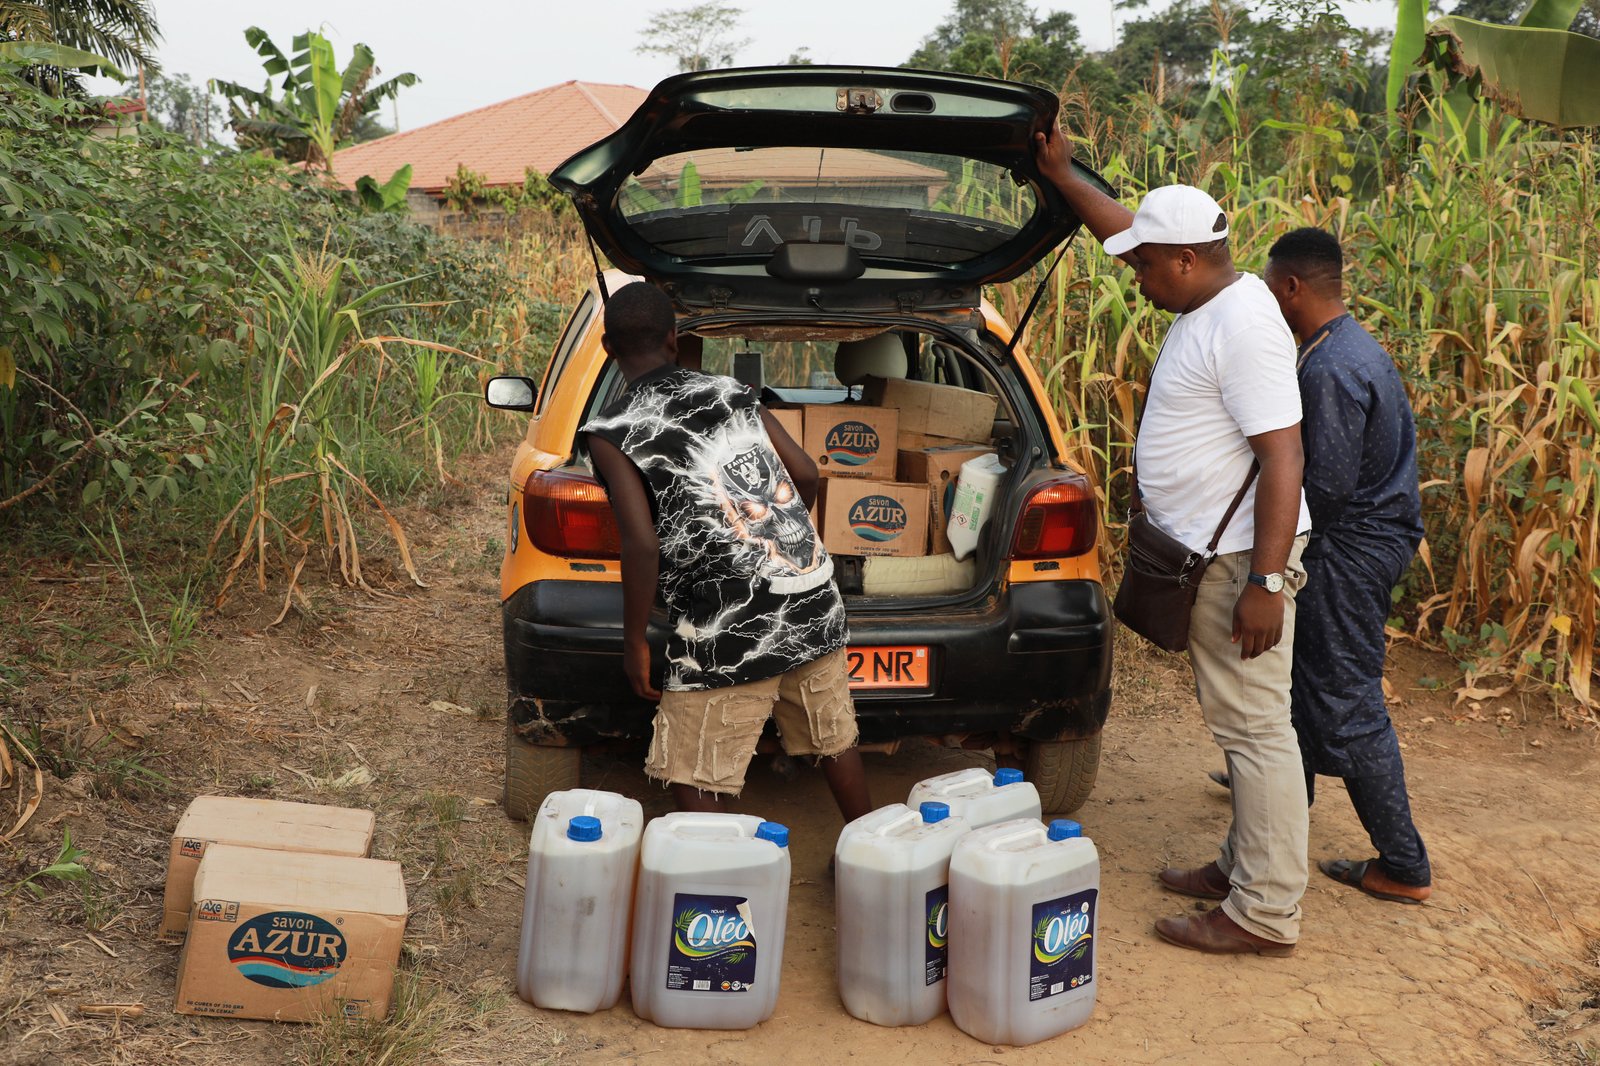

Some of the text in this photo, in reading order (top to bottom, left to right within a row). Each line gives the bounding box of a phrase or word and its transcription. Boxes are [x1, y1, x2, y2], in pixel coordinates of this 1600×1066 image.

[843, 424, 864, 432] savon
[827, 431, 877, 448] AZUR
[726, 450, 757, 470] RAIDERS
[868, 498, 890, 506] savon
[851, 505, 905, 523] AZUR
[873, 651, 915, 682] NR
[271, 916, 314, 930] savon
[686, 913, 750, 947] Oléo
[233, 927, 342, 958] AZUR
[1044, 914, 1089, 953] Oléo
